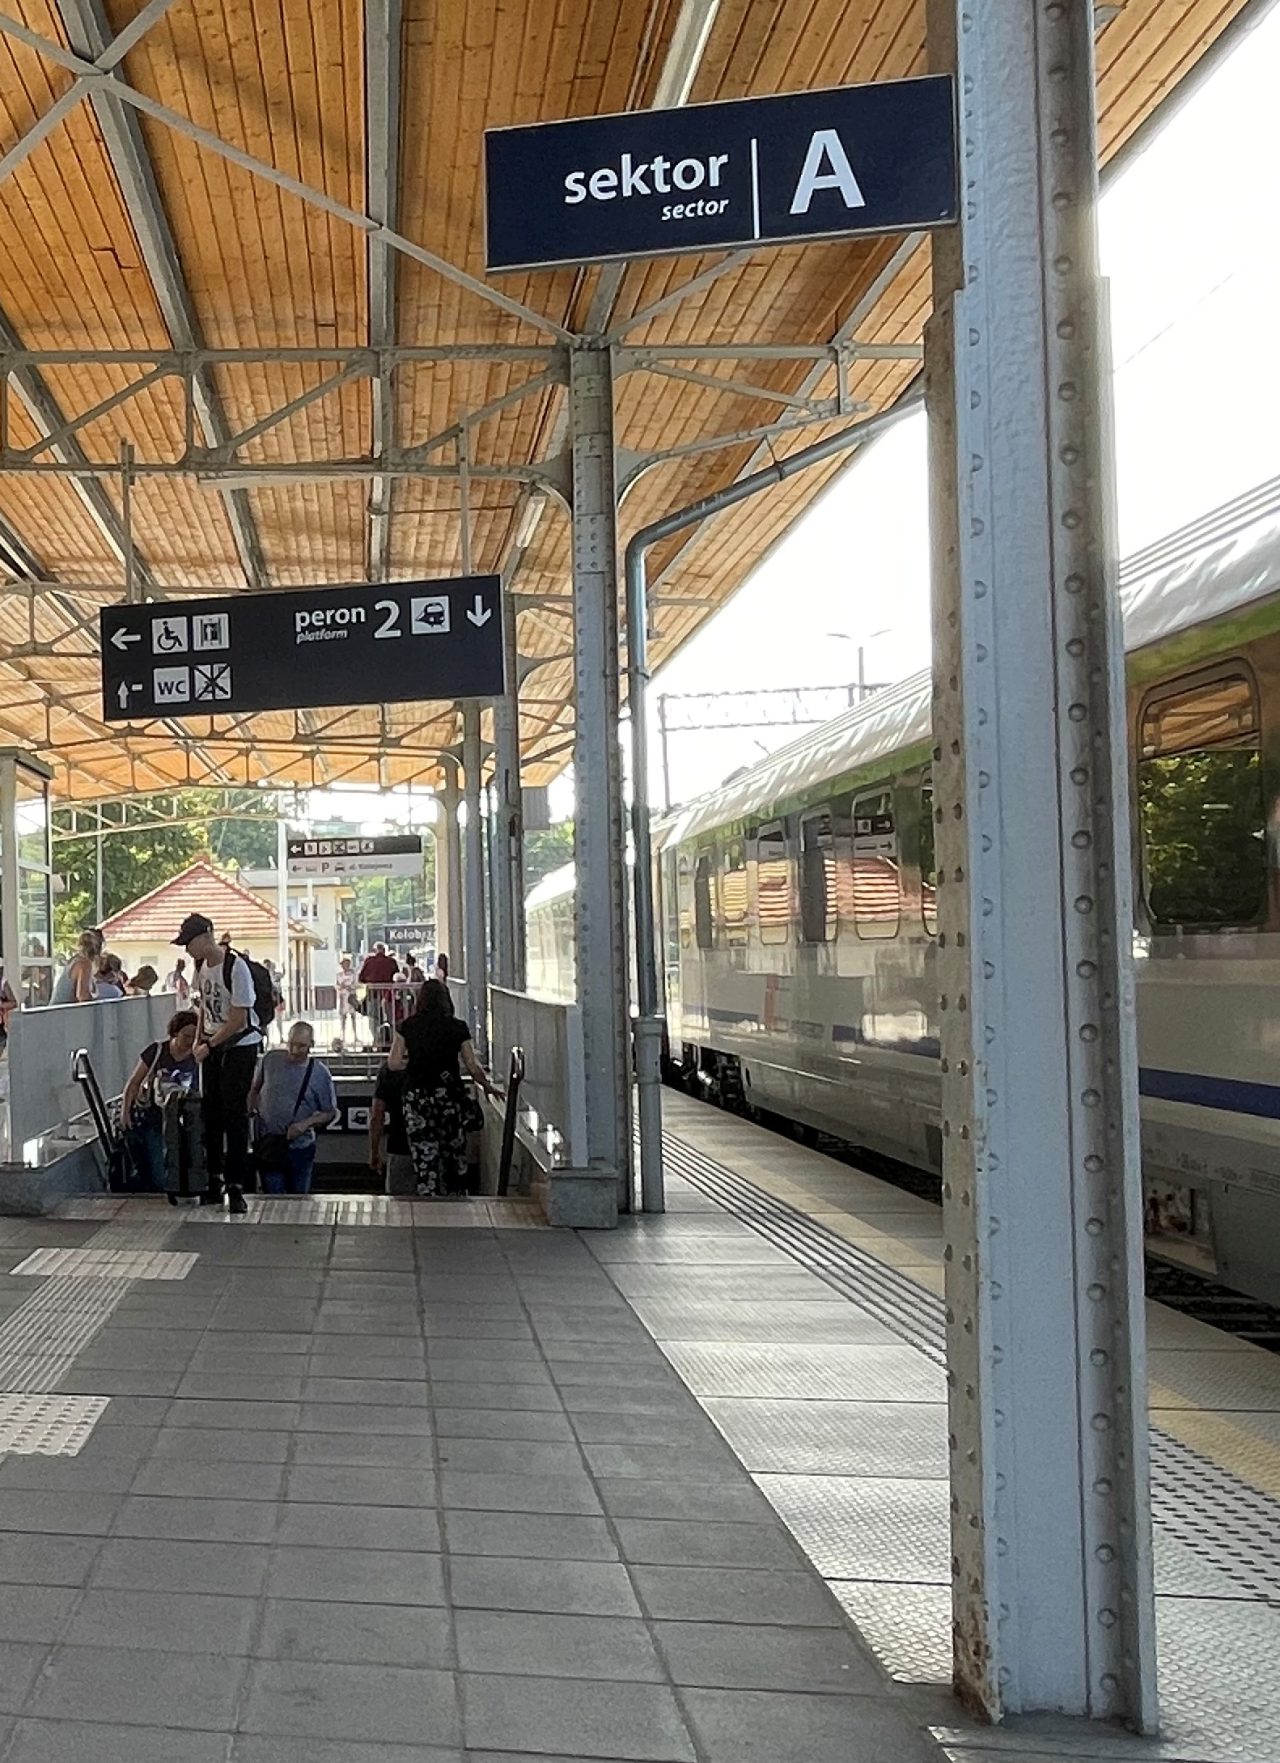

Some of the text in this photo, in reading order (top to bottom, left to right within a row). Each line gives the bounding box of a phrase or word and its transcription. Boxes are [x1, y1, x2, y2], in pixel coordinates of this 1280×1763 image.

[564, 128, 866, 215] sektor A
[661, 197, 729, 221] sector
[295, 599, 402, 638] peron 2
[296, 628, 348, 643] platform
[157, 679, 186, 696] WC
